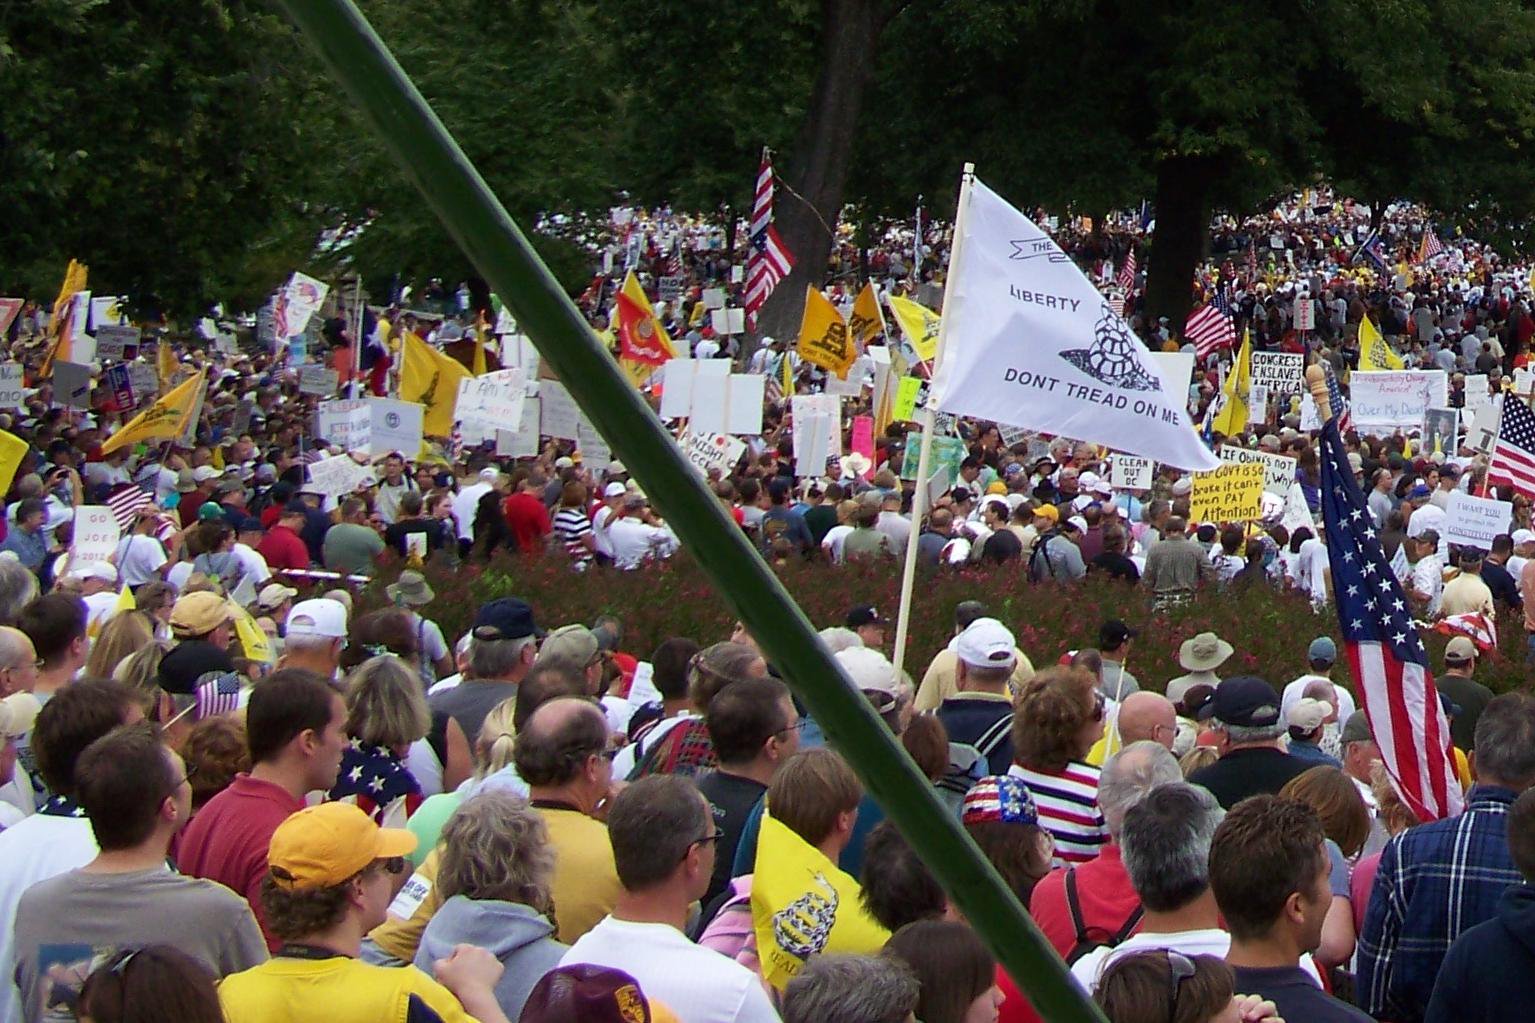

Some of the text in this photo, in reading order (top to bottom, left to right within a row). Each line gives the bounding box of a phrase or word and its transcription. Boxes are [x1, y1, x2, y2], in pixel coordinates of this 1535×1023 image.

[1032, 241, 1053, 252] THE
[1010, 284, 1080, 312] LIBERTY
[1253, 353, 1303, 366] CONGRESS
[1253, 366, 1303, 380] ENSLAVES
[1004, 368, 1180, 426] DONT TREAD ON ME
[1118, 456, 1149, 468] CLEAN
[1124, 467, 1140, 477] OUT
[1126, 477, 1137, 486] DC
[1225, 493, 1245, 504] PAY
